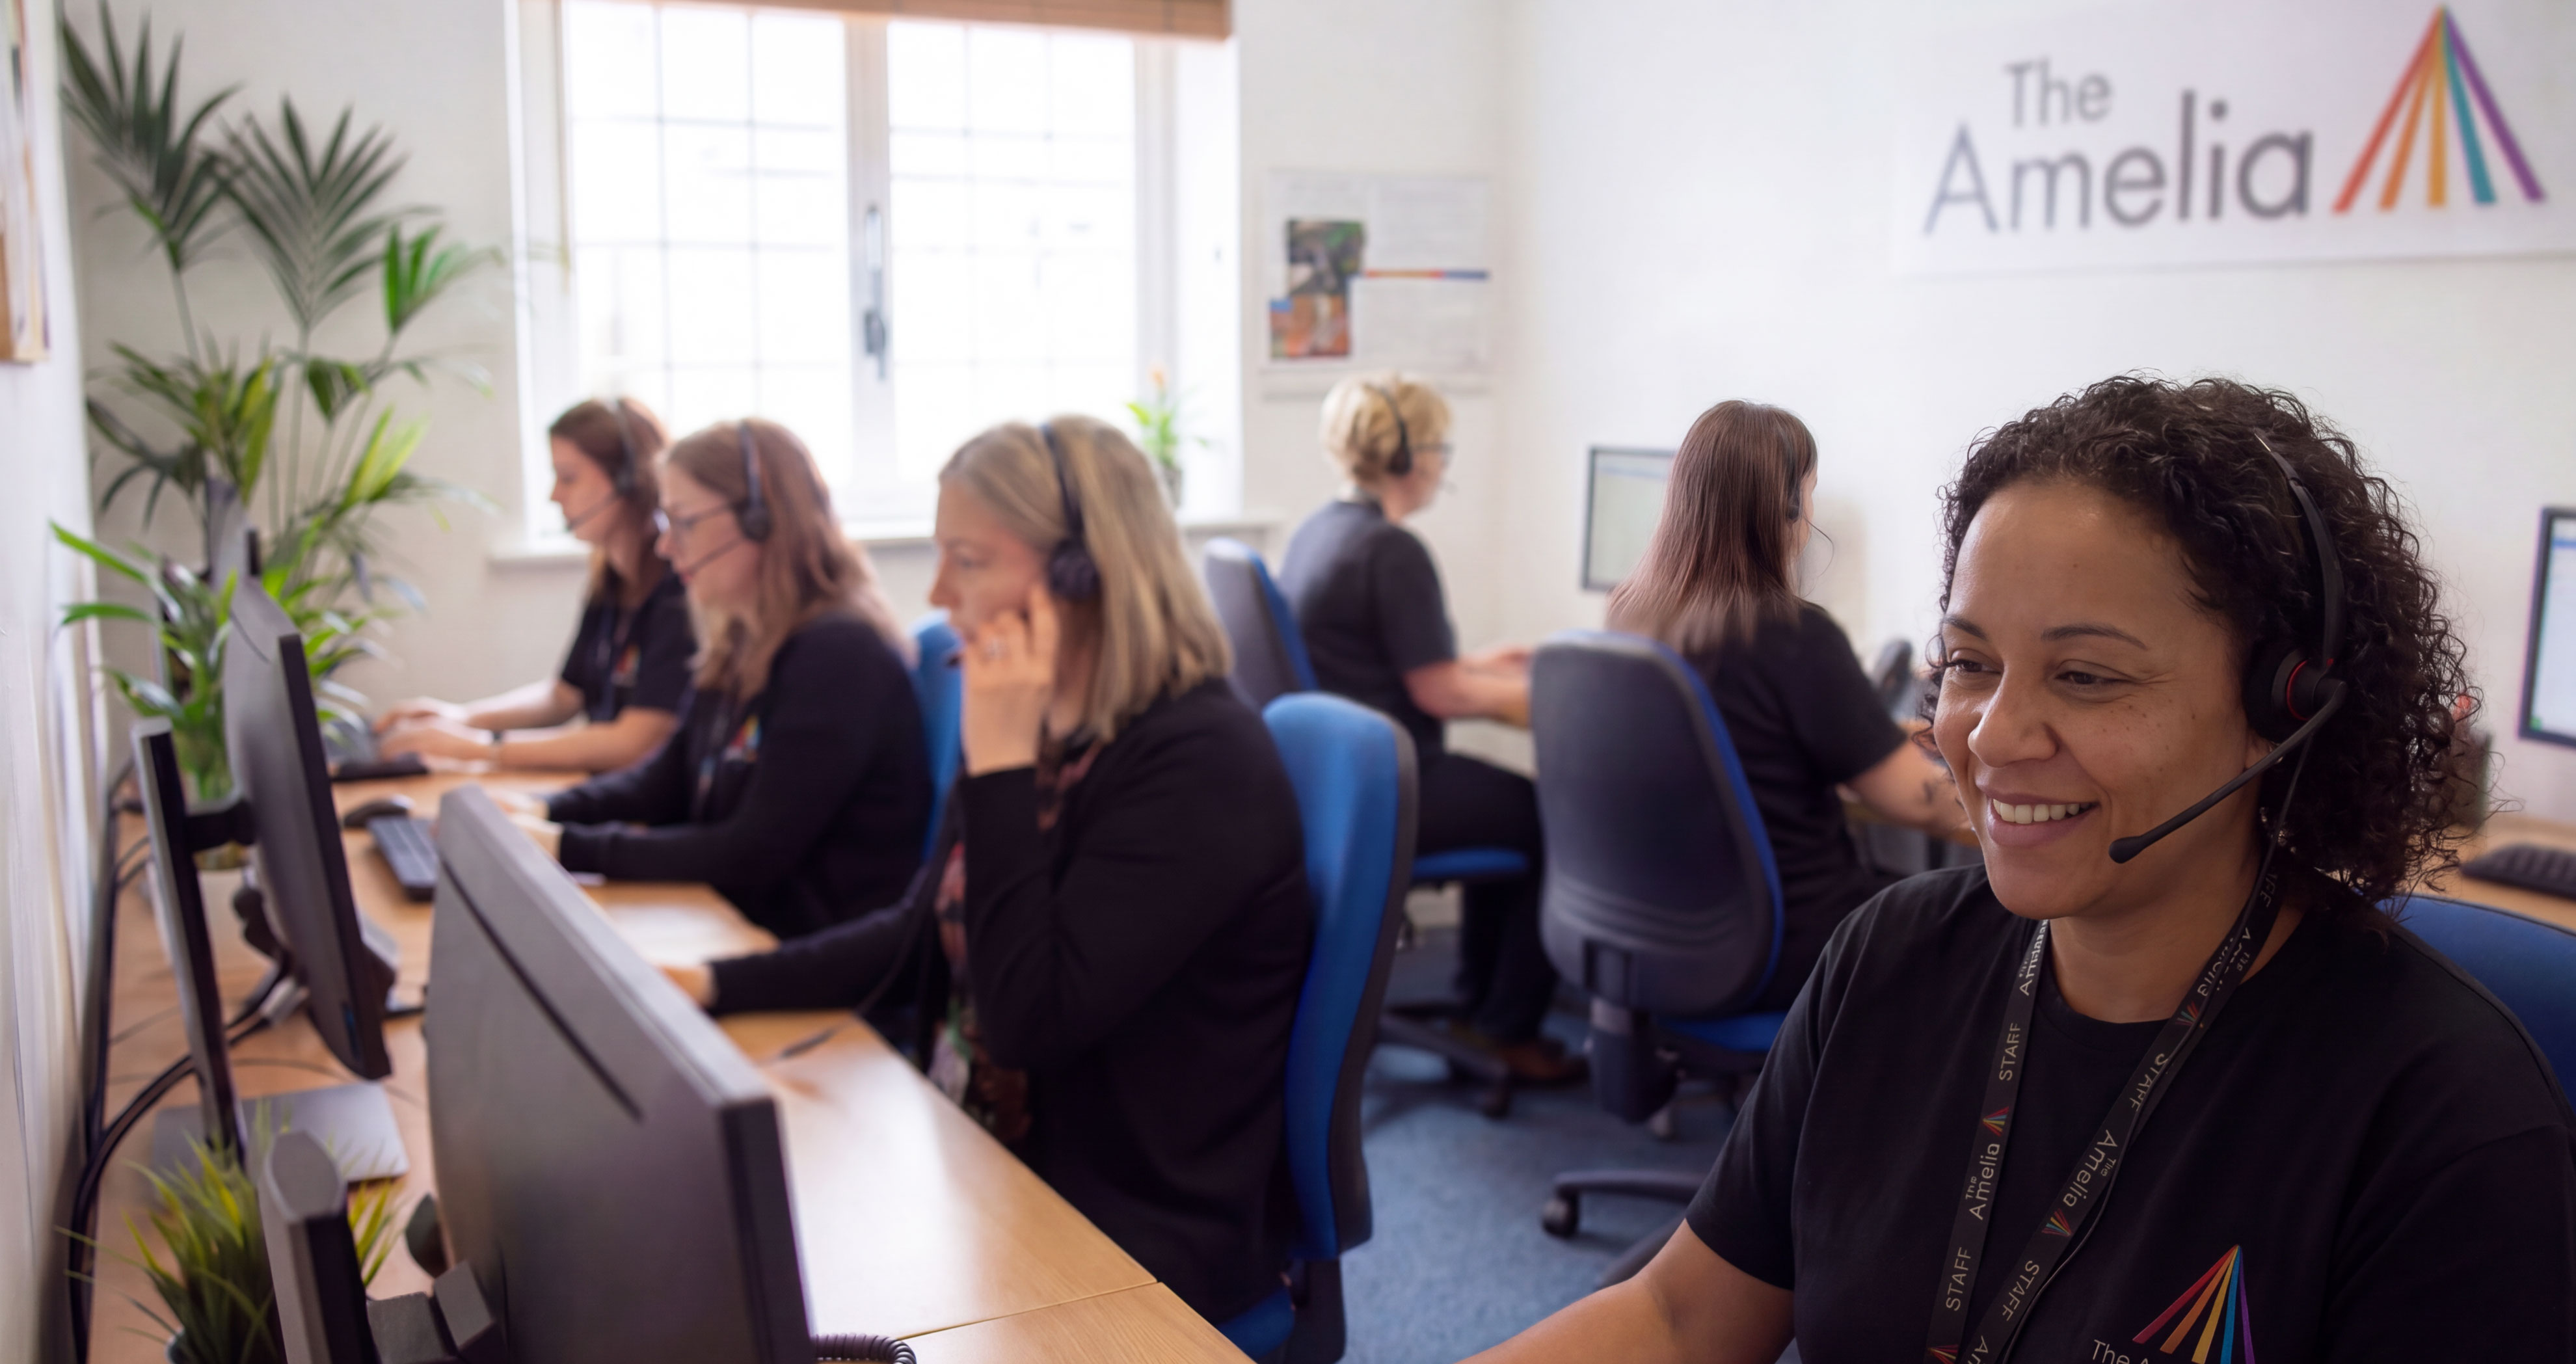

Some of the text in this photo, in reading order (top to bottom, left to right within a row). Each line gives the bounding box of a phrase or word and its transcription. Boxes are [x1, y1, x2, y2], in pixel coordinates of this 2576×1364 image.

[2004, 57, 2112, 127] The
[1924, 90, 2313, 234] Amelia
[2197, 927, 2251, 996] Alia
[1999, 1023, 2020, 1081] STAFF
[1969, 1143, 2000, 1220] Amelia
[2063, 1129, 2118, 1207] Amelia
[1946, 1247, 1971, 1311] STAFF
[2002, 1260, 2039, 1321] STAFF
[2093, 1339, 2130, 1364] The
